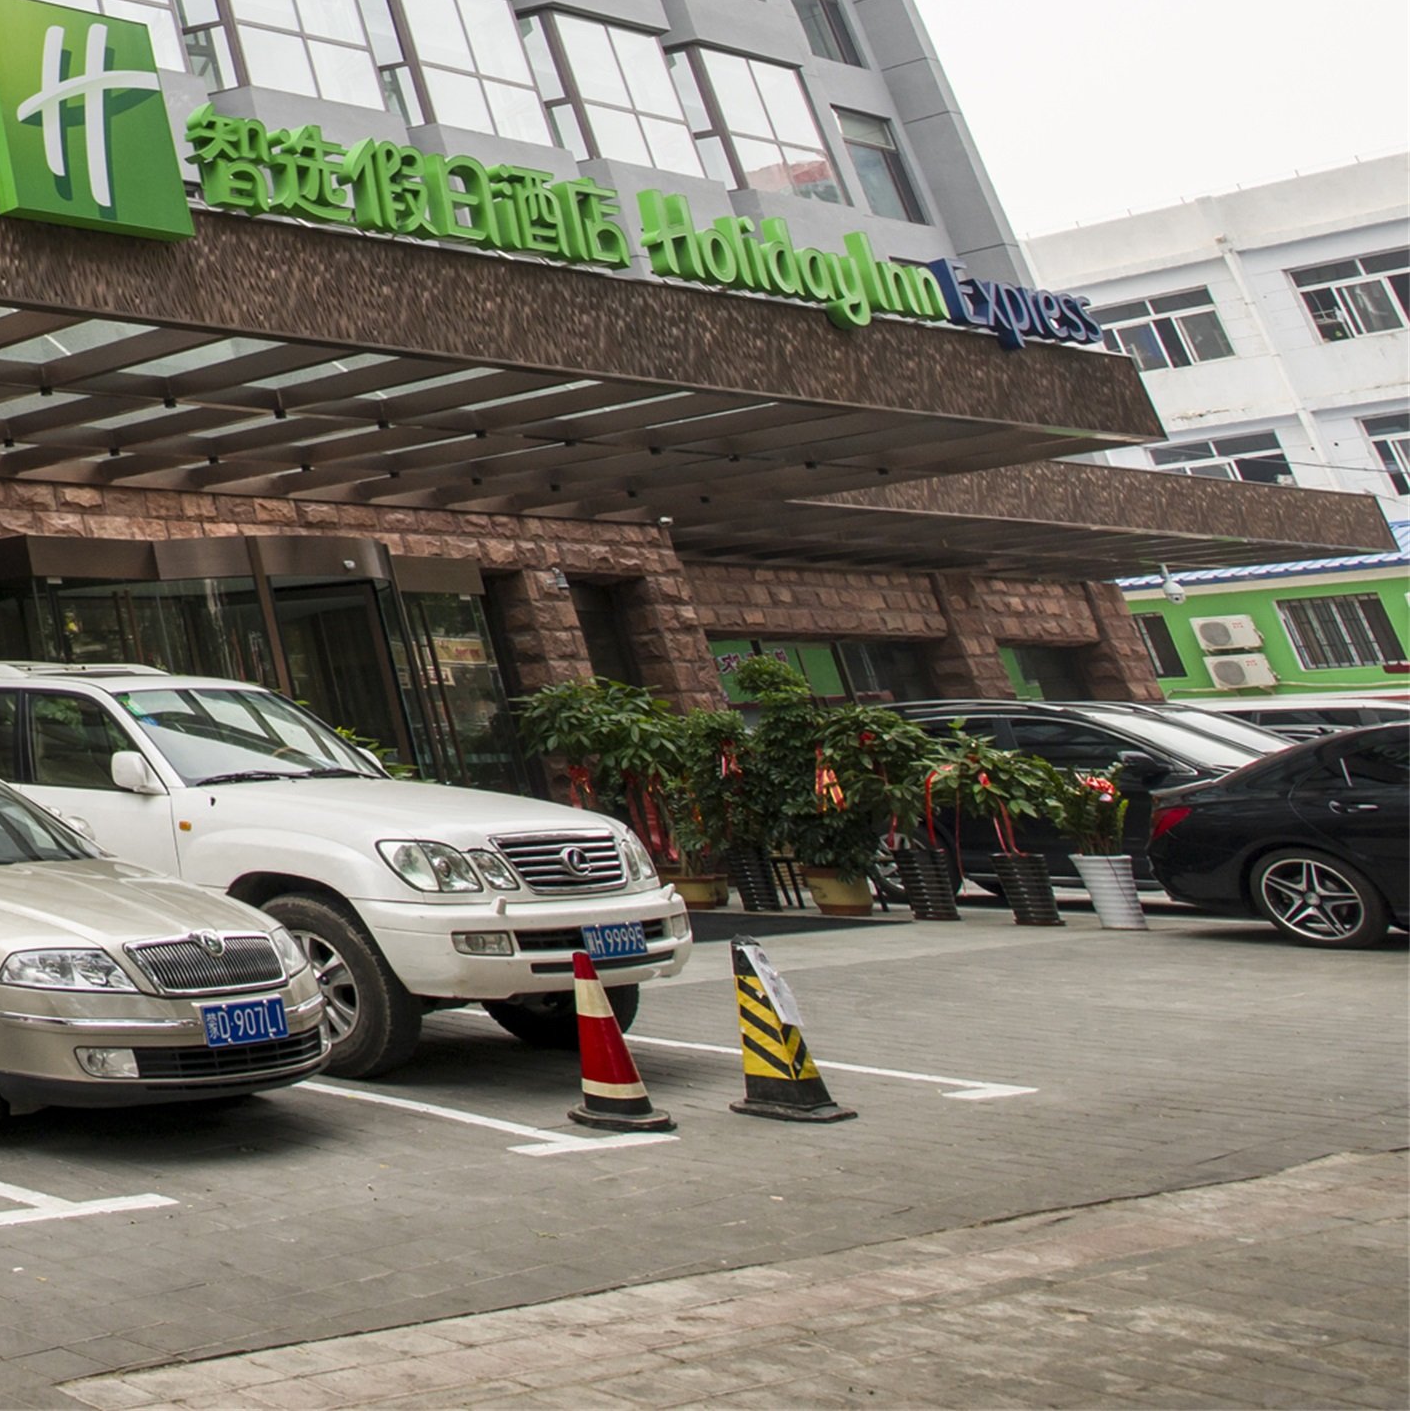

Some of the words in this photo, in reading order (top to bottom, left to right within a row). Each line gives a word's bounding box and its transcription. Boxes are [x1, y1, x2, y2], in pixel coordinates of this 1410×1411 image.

[185, 103, 631, 270] 智选假日酒店
[636, 189, 871, 329] Holiday
[843, 231, 949, 321] Inn
[930, 258, 1103, 351] Express
